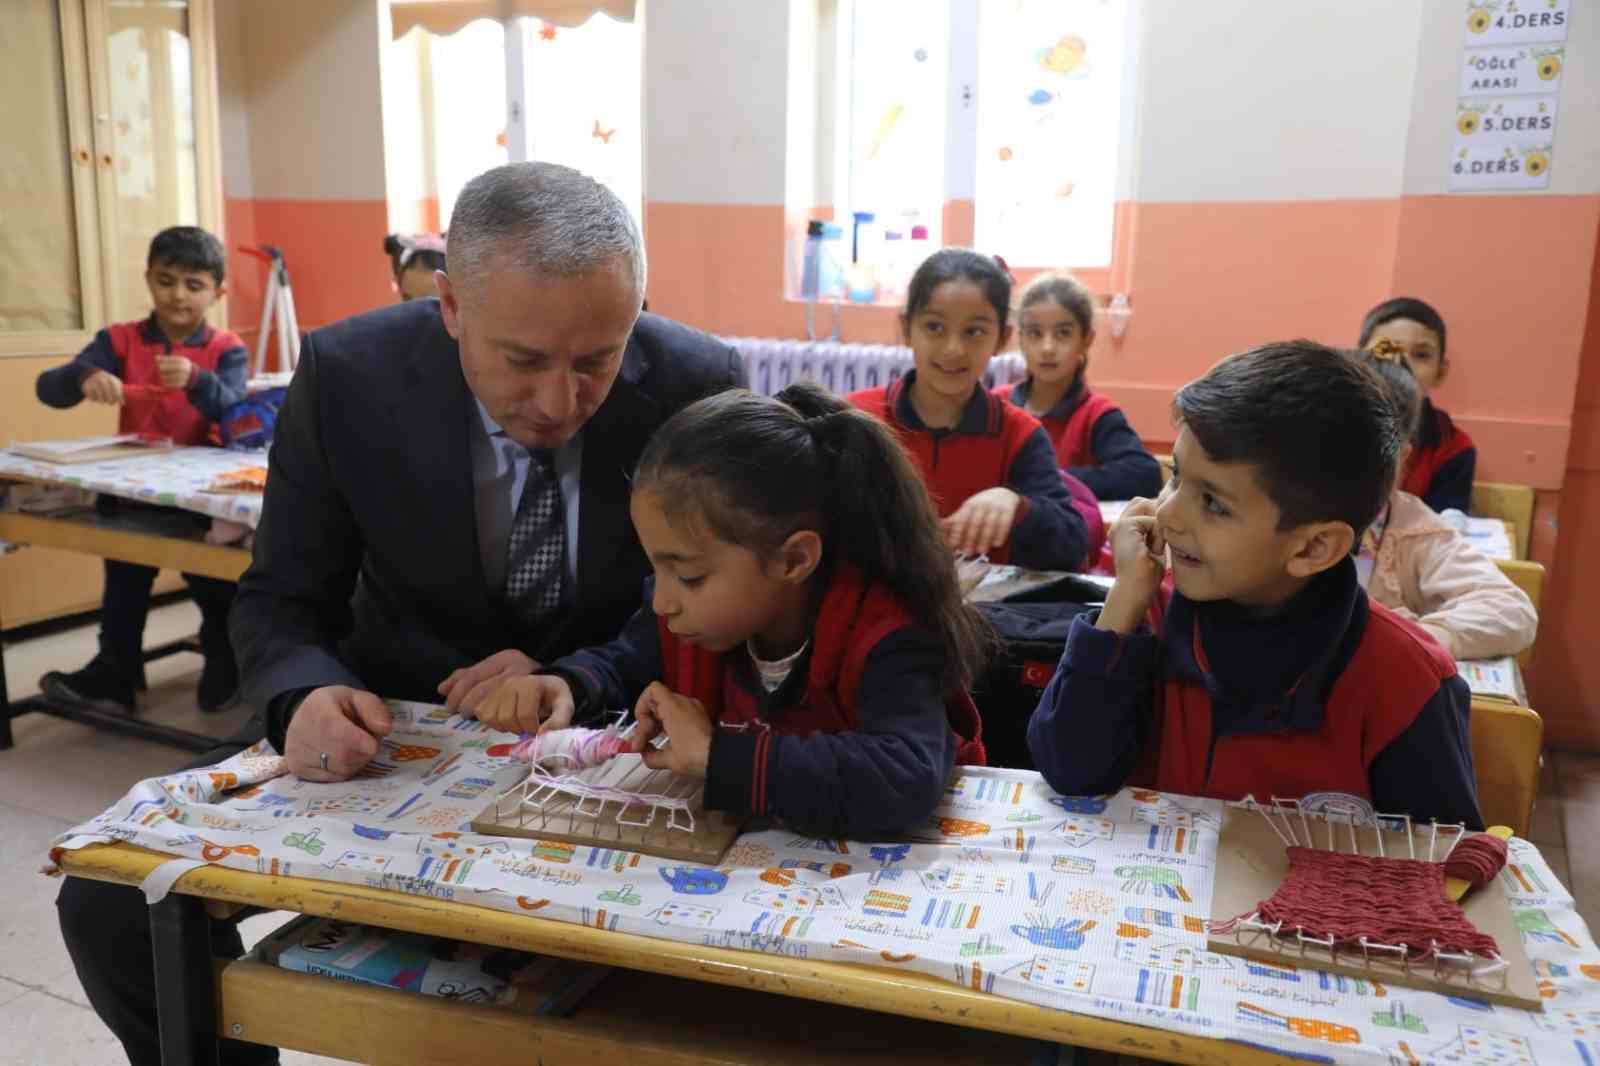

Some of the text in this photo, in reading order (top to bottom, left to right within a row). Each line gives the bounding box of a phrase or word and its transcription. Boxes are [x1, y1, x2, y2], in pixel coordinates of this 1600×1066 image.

[1496, 12, 1565, 29] 4.DERS
[1471, 77, 1518, 91] ARASI
[1483, 116, 1552, 132] 5.DERS
[1453, 160, 1520, 175] 6.DERS
